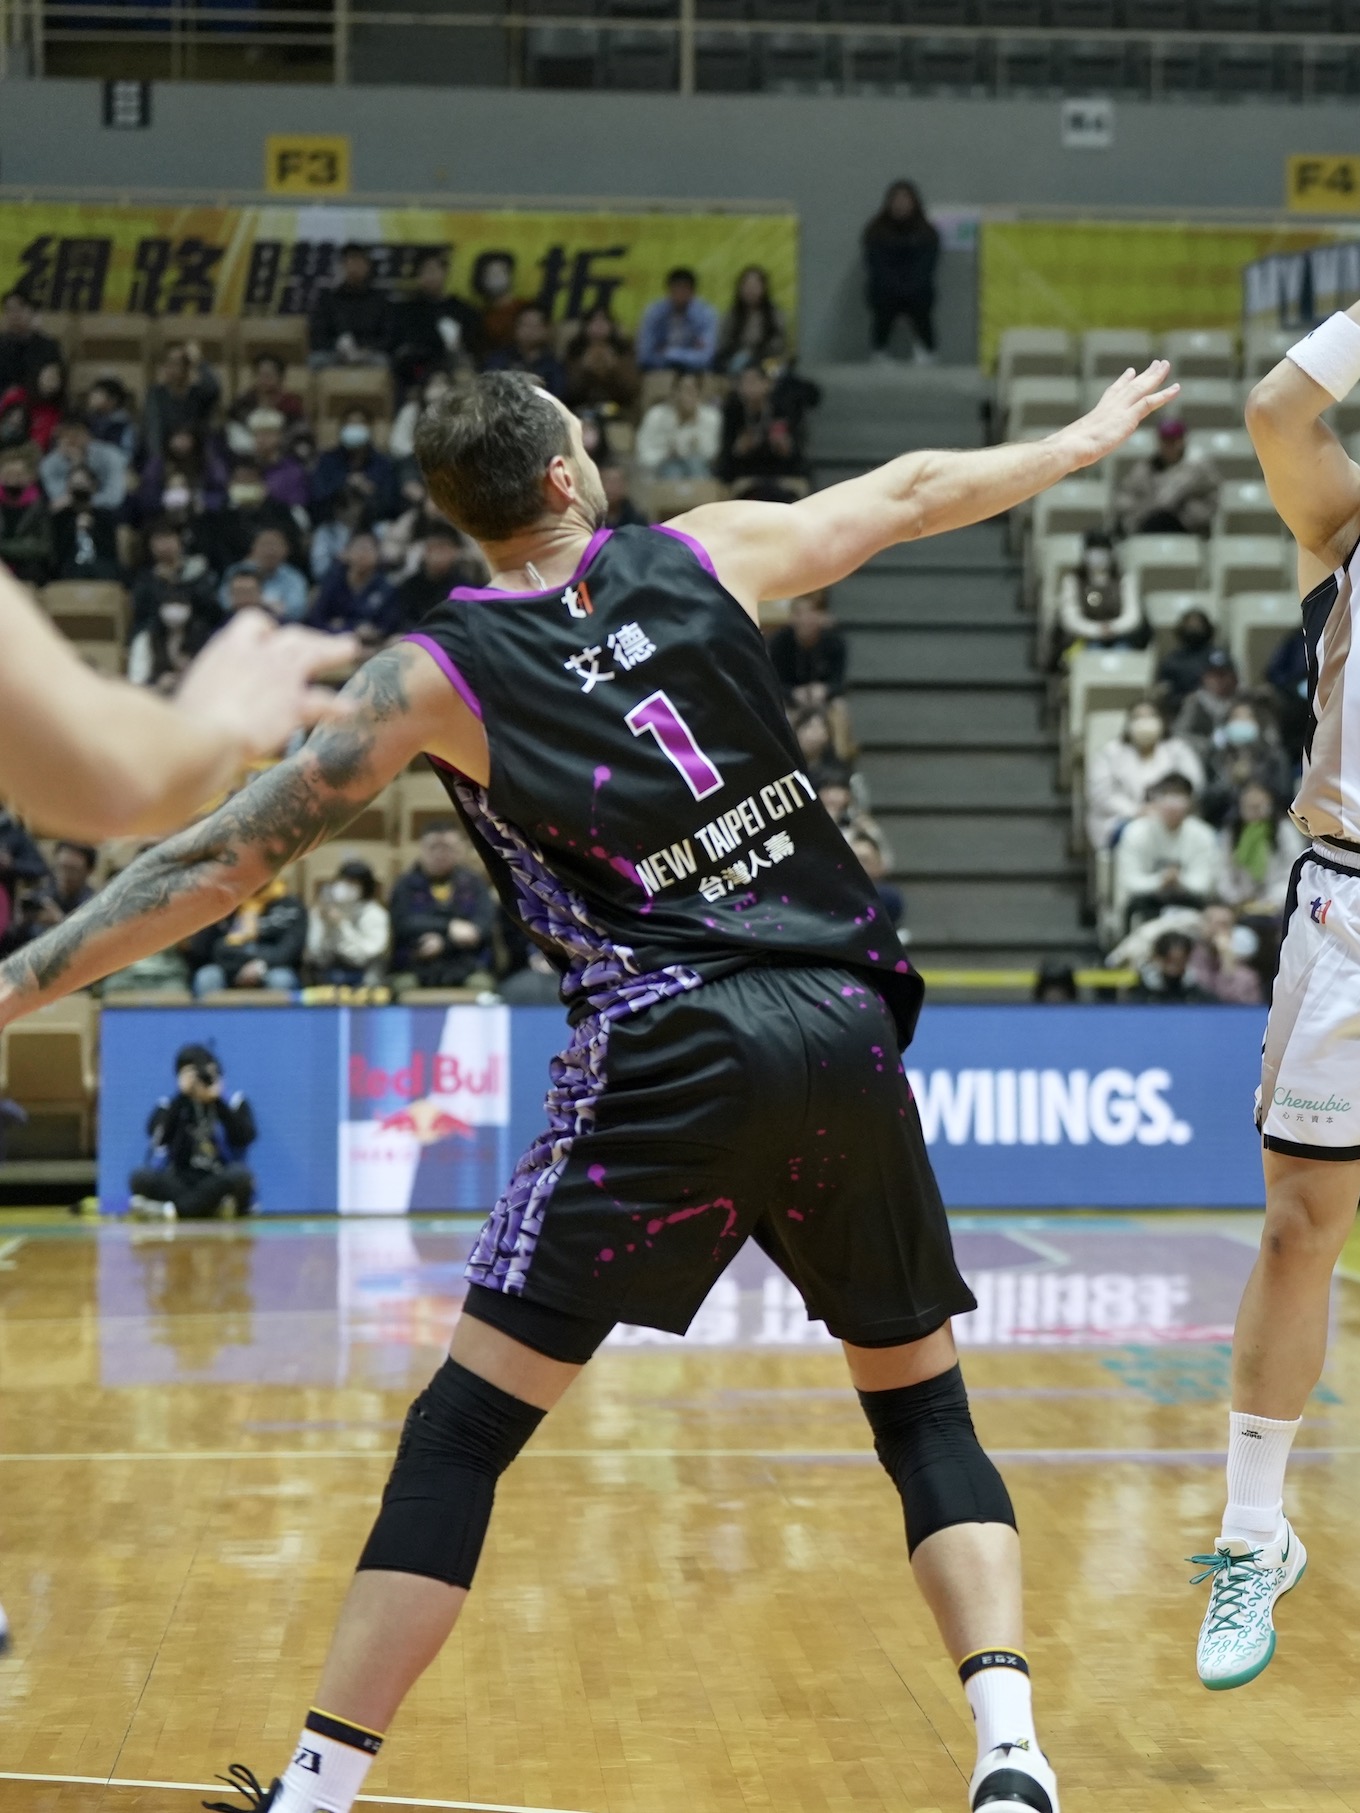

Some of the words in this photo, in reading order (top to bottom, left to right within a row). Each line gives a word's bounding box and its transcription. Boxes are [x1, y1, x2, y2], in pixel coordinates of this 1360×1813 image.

[275, 149, 339, 184] F3
[1294, 162, 1355, 196] F4
[563, 621, 657, 694] 艾德
[624, 689, 725, 802] 1
[635, 838, 698, 897] NEW
[694, 796, 766, 863] TAIPEI
[759, 769, 818, 821] CITY
[698, 830, 795, 903] 台灣人壽
[907, 1067, 1193, 1146] WIIINGS.
[1274, 1087, 1352, 1112] Cherubic
[1282, 1111, 1334, 1124] 心元資本
